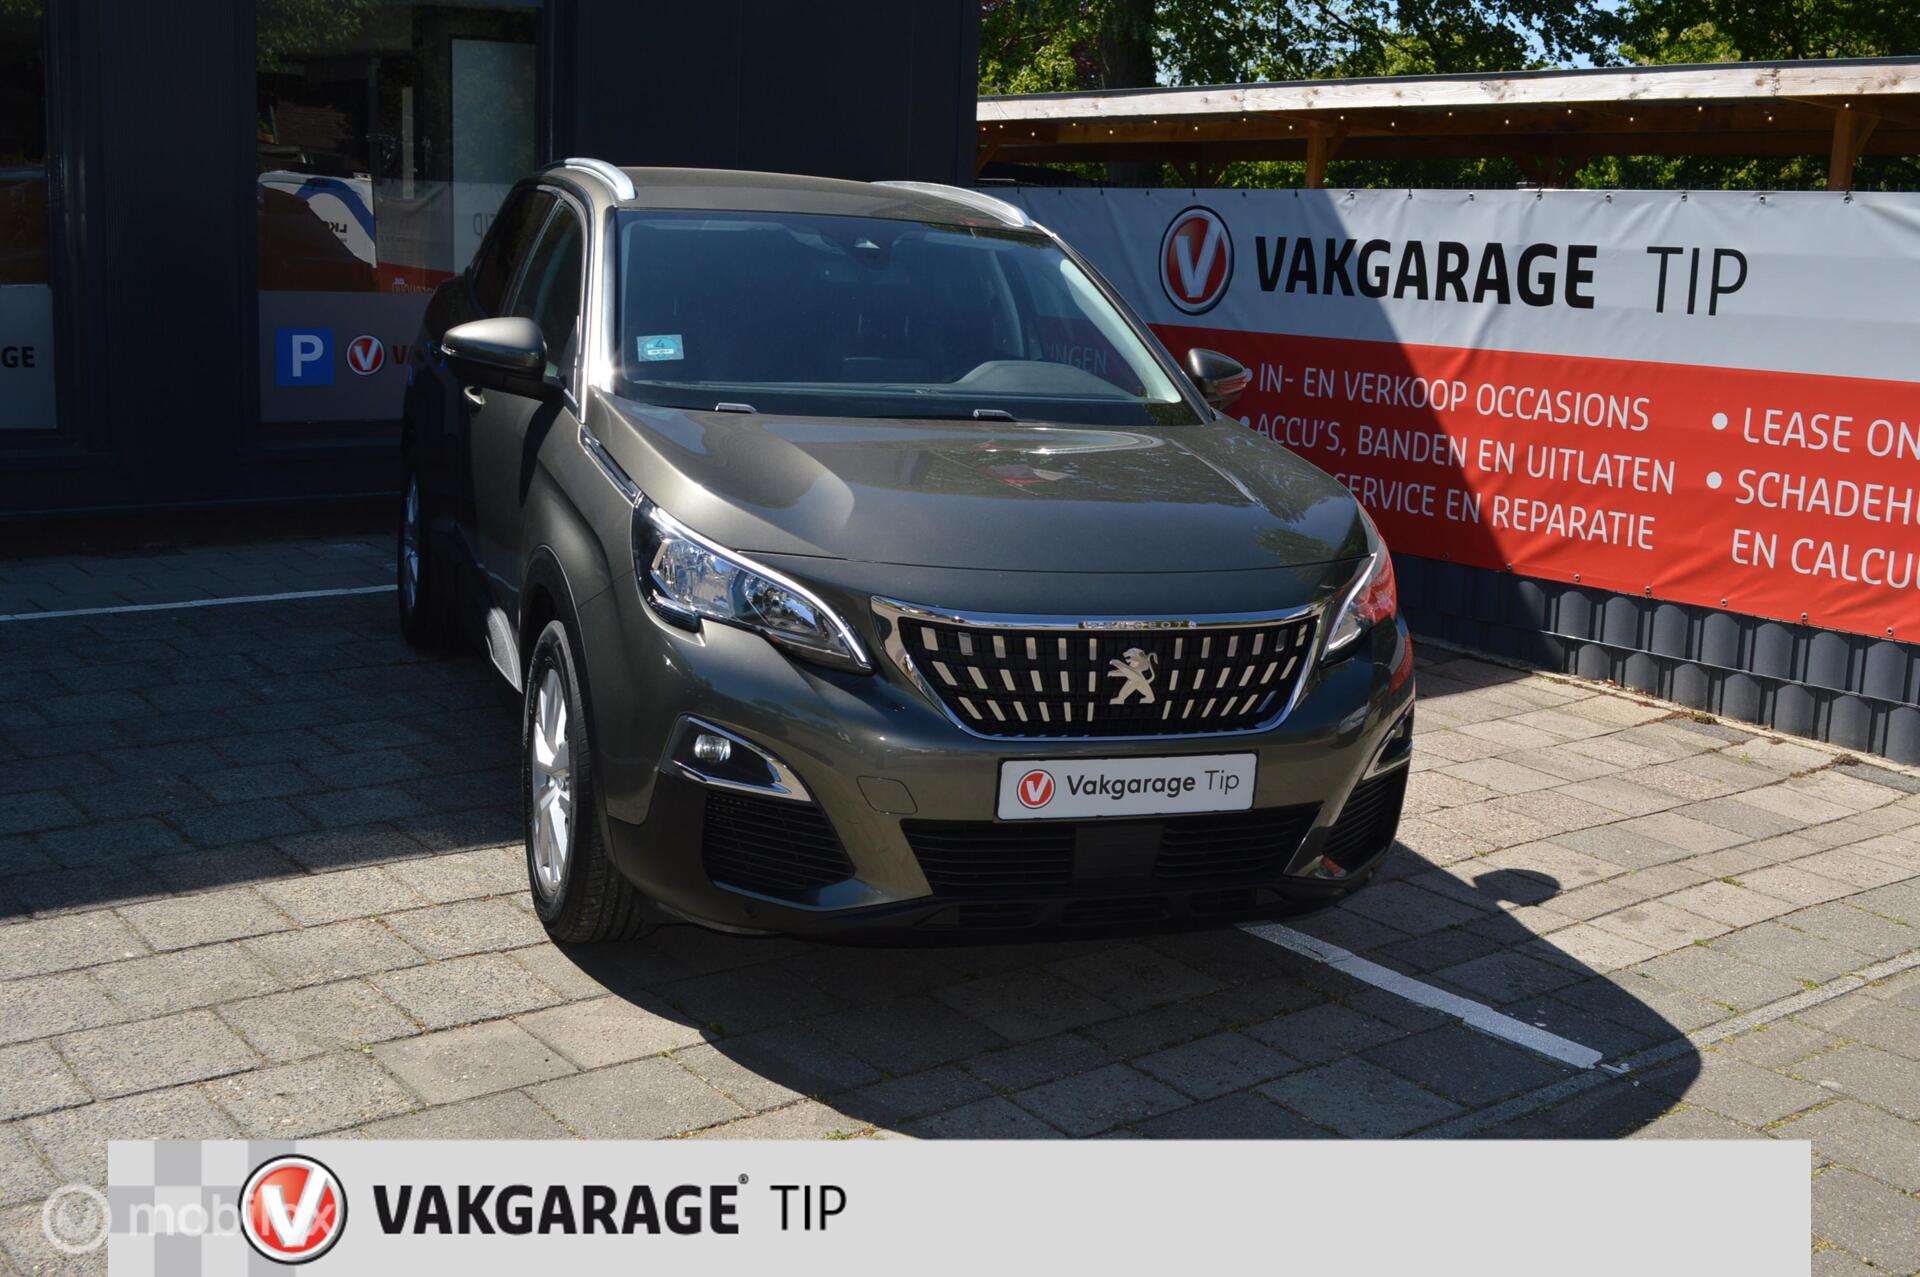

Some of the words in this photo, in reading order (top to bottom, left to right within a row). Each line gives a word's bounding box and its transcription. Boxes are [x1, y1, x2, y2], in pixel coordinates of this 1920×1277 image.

[1256, 236, 1598, 309] VAKGARAGE
[1646, 246, 1748, 316] TIP
[292, 335, 324, 377] P
[1259, 363, 1294, 393] IN-
[1303, 367, 1335, 399] EN
[1344, 370, 1467, 412] VERKOOP
[1476, 383, 1650, 432] OCCASIONS
[1256, 413, 1346, 457] ACCU'S,
[1357, 425, 1467, 468] BANDEN
[1478, 439, 1515, 474] EN
[1527, 444, 1675, 495] UITLATEN
[1743, 407, 1853, 453] LEASE
[1446, 489, 1482, 524] EN
[1492, 495, 1656, 551] REPARATIE
[1735, 469, 1920, 525] SCHADEH
[1731, 528, 1777, 569] EN
[1791, 538, 1920, 589] CALCU
[1066, 774, 1197, 800] Vakgarage
[1204, 769, 1240, 795] Tip
